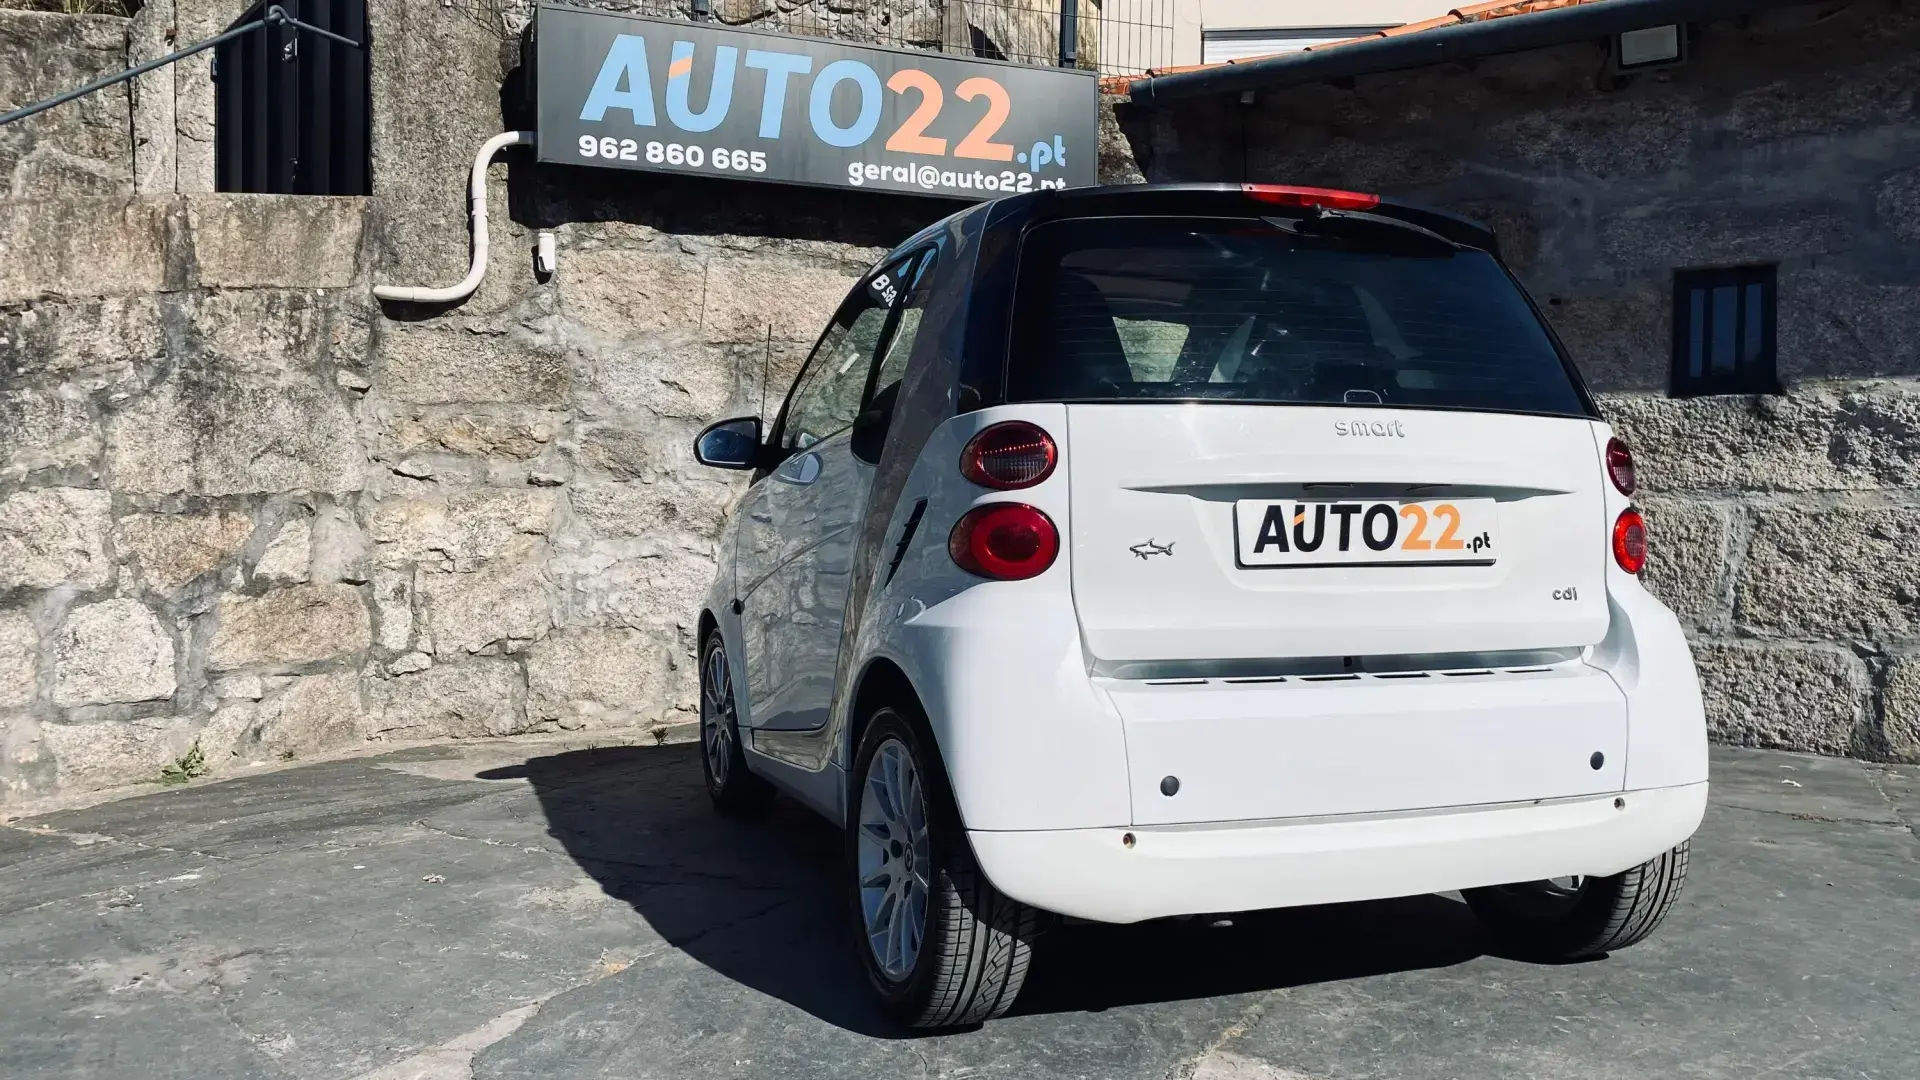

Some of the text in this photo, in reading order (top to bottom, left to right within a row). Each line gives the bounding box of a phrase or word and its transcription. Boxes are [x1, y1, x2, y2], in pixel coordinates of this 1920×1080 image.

[579, 135, 767, 173] 962 860 665
[1334, 419, 1405, 439] smart
[1253, 503, 1491, 553] AUTO22.pt
[1552, 587, 1577, 601] cdi
